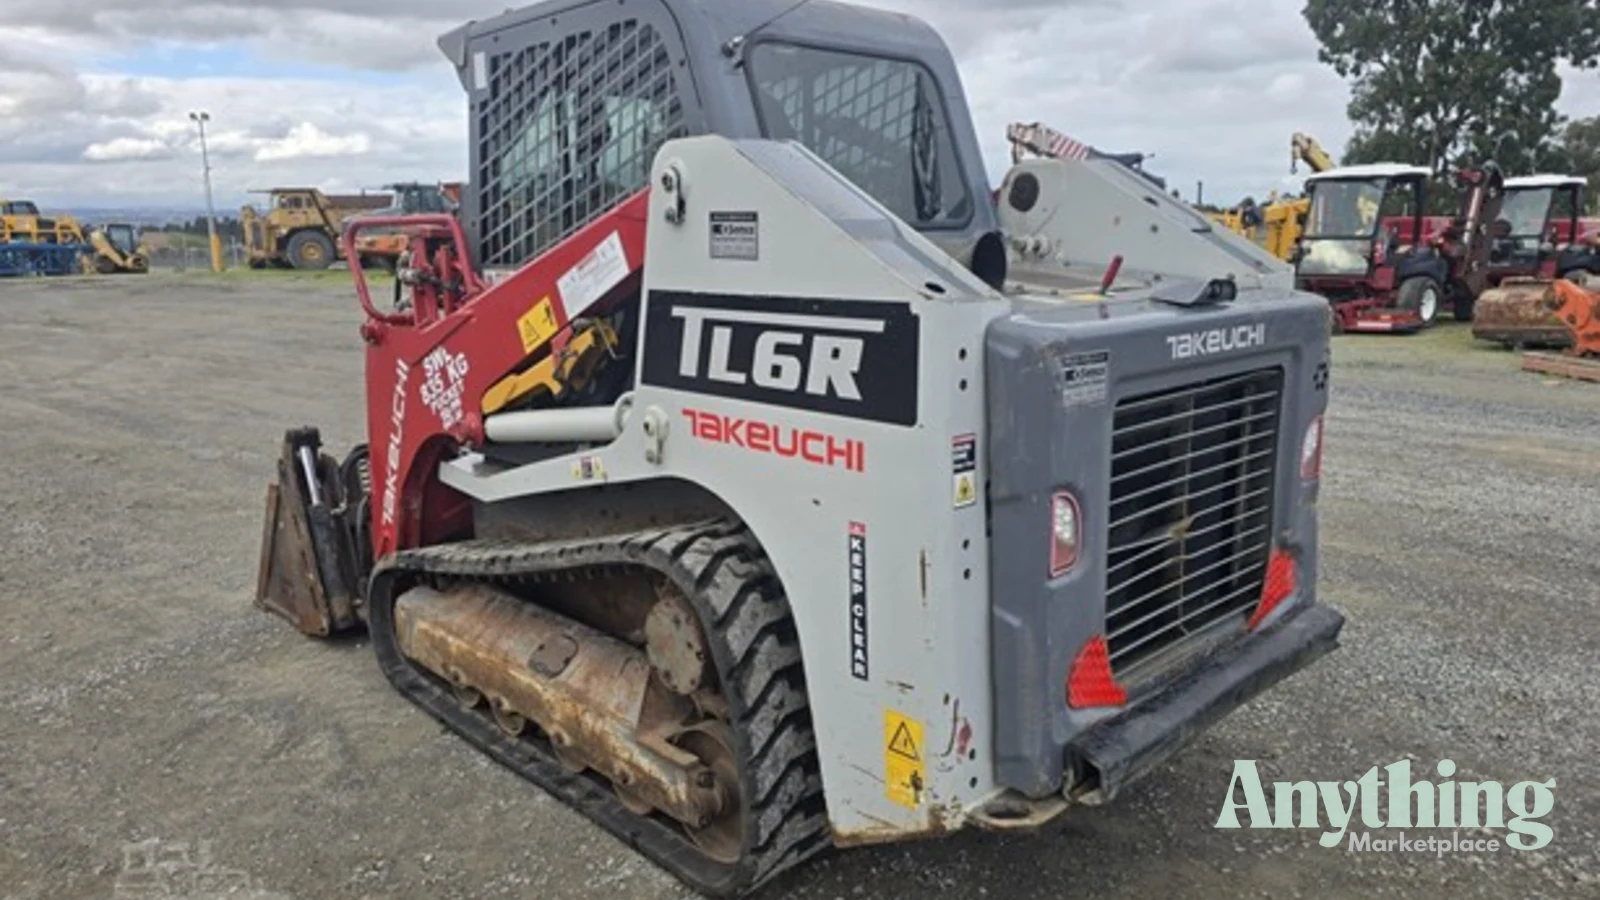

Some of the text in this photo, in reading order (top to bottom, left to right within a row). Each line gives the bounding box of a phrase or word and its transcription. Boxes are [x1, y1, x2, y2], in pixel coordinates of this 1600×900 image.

[446, 352, 469, 384] KG
[671, 305, 885, 400] TL6R
[1167, 323, 1265, 359] TAKEUCHI
[681, 408, 865, 472] TAKEUCHI
[851, 537, 864, 595] KEEP
[853, 603, 867, 677] CLEAR
